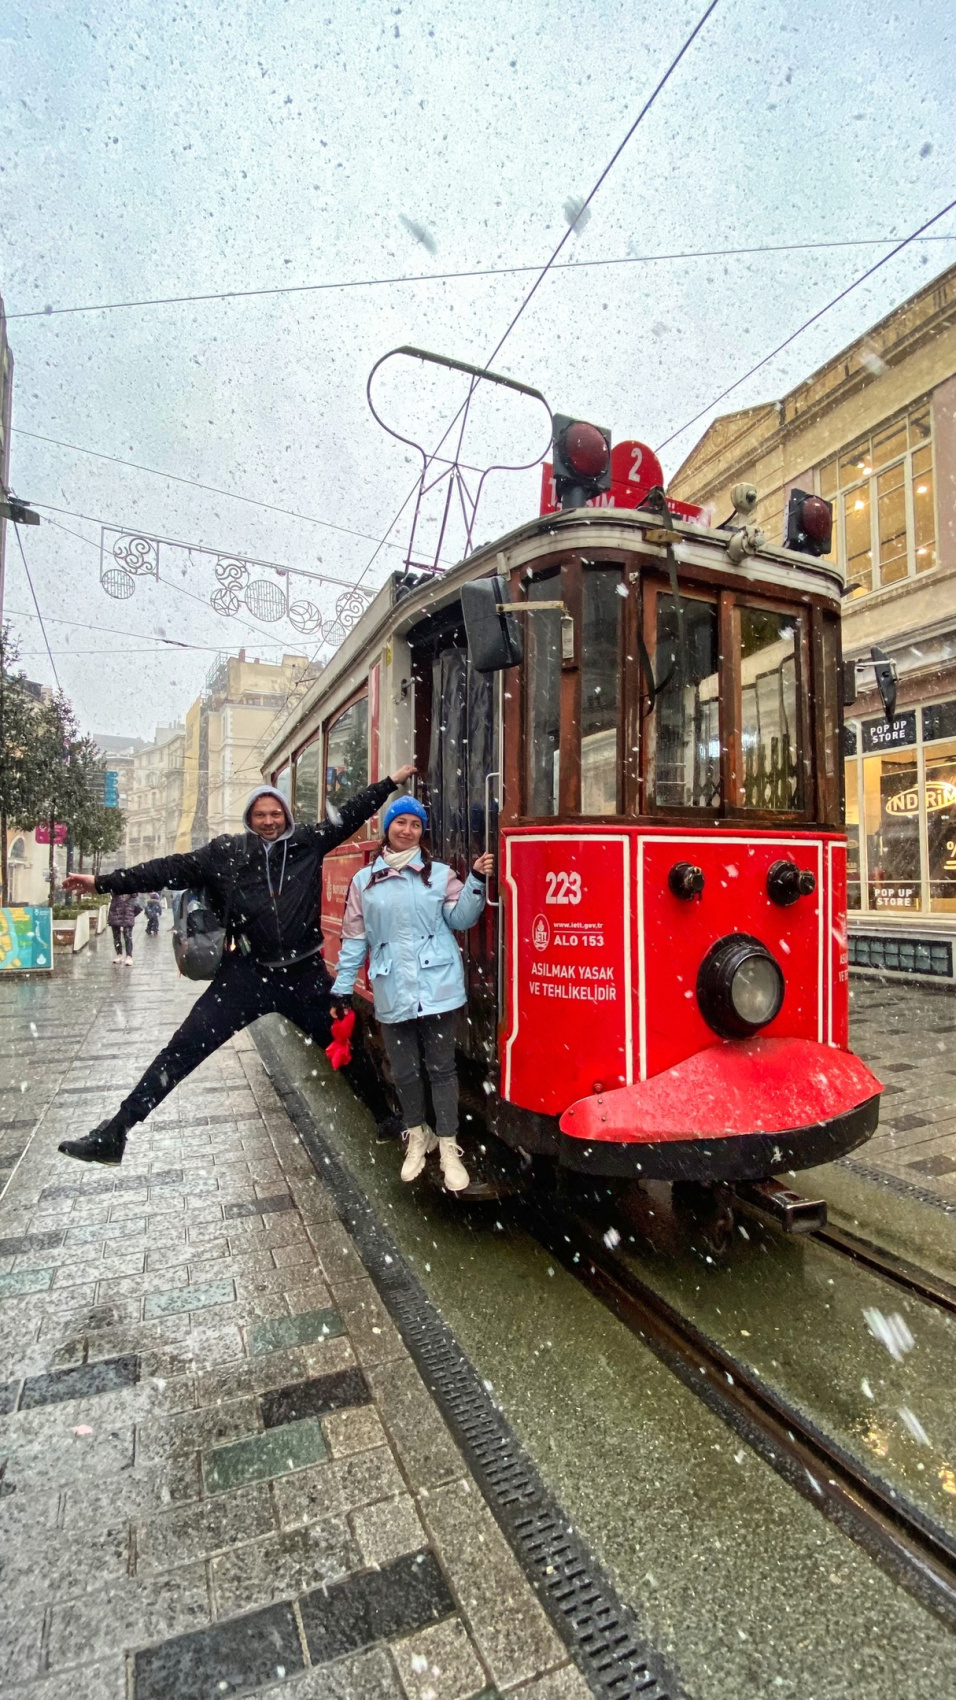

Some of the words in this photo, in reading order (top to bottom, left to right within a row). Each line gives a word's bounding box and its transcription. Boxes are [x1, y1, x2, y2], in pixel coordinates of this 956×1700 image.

[628, 447, 643, 482] 2
[870, 724, 890, 736] POP
[893, 720, 907, 731] UP
[872, 730, 906, 744] STORE
[545, 871, 582, 905] 223
[874, 888, 895, 897] POP
[898, 888, 913, 897] UP
[876, 897, 911, 907] STORE
[553, 922, 604, 930] www.iett.gov.tr
[553, 934, 579, 947] ALO
[582, 935, 604, 947] 153
[531, 962, 576, 979] ASILMAK
[578, 966, 615, 980] YASAK
[529, 981, 541, 995] VE
